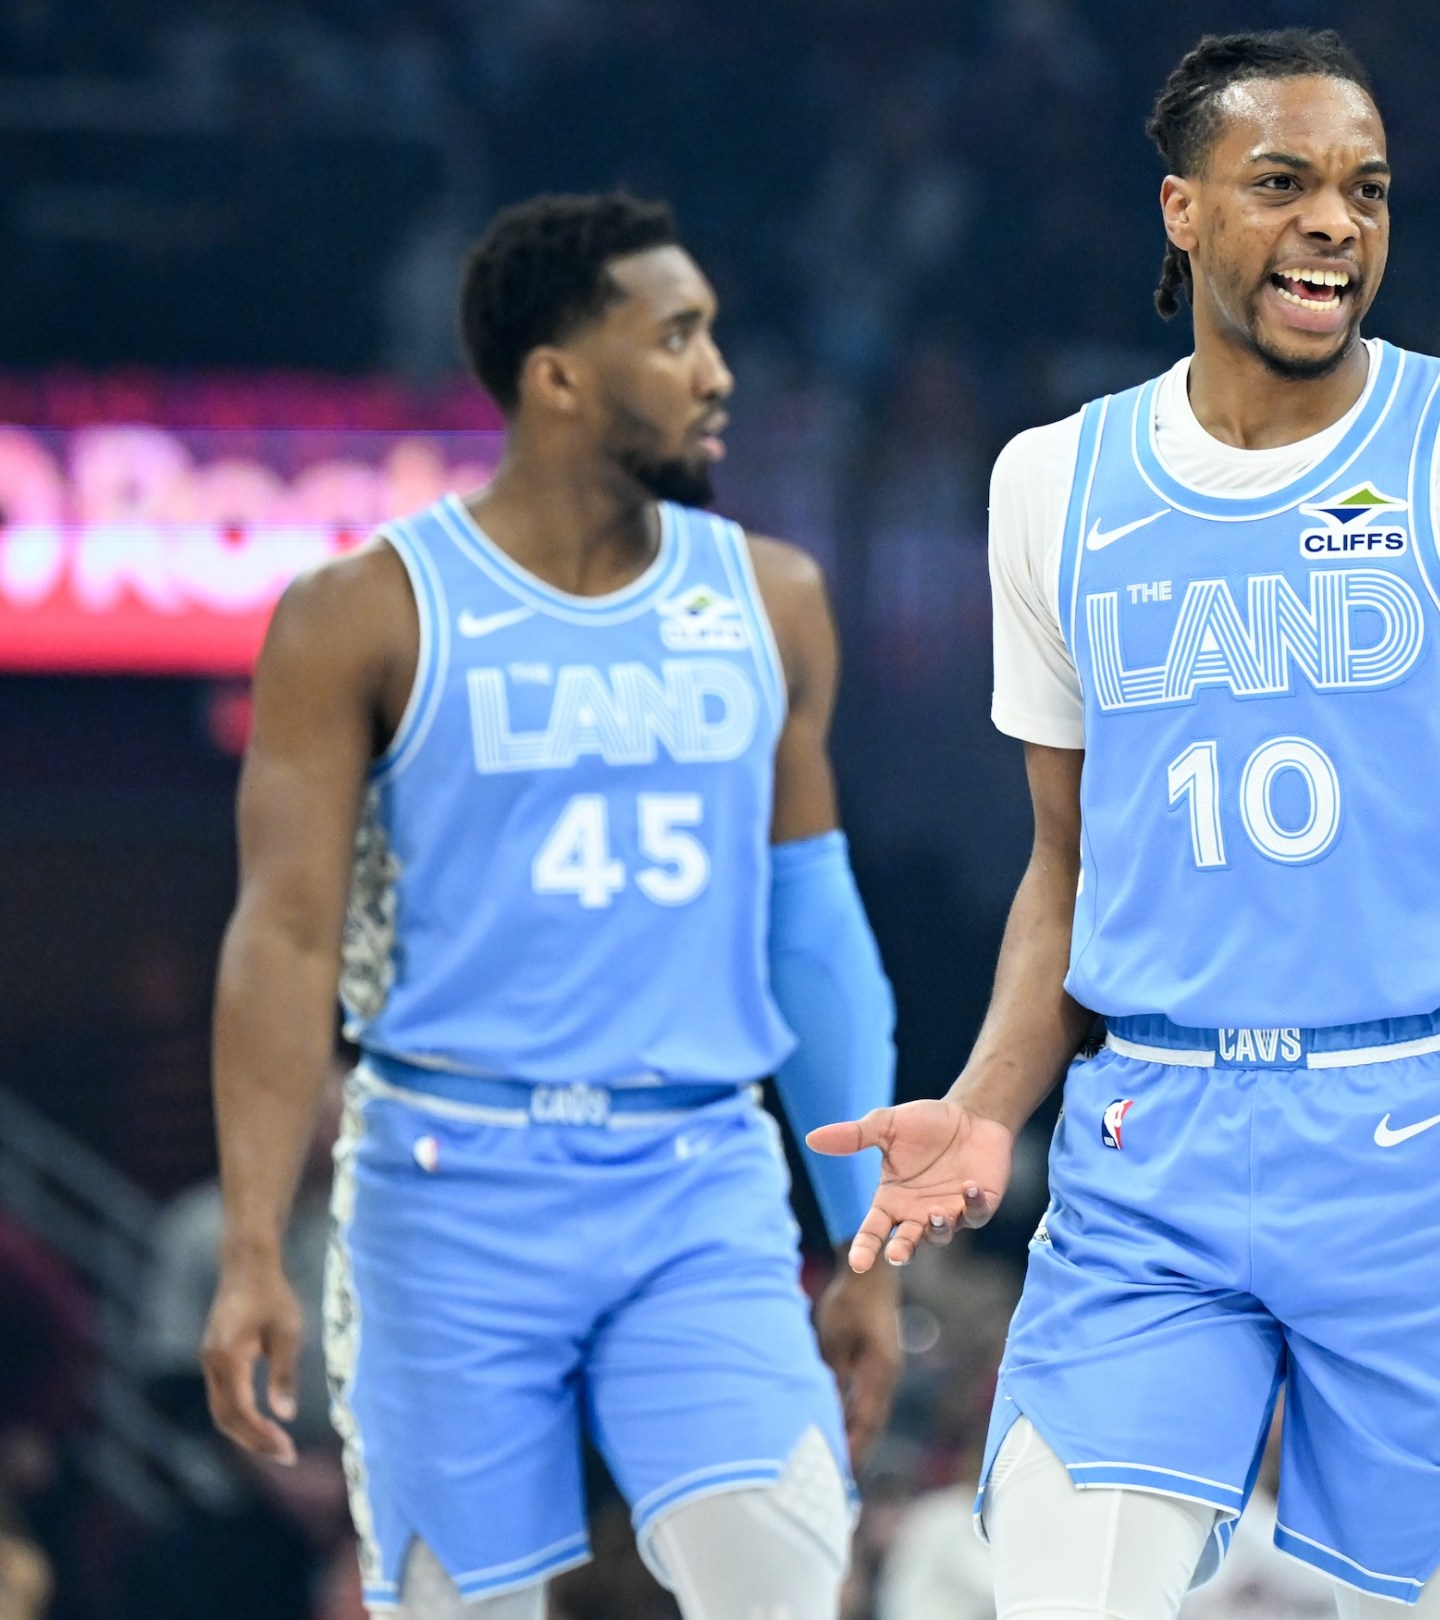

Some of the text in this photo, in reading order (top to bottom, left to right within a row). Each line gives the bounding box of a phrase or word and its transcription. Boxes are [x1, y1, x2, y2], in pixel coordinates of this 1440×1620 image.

[1126, 580, 1173, 604] THE
[1304, 532, 1404, 553] CLIFFS
[1085, 568, 1426, 712] LAND
[467, 658, 759, 774] LAND
[531, 792, 711, 909] 45
[1167, 735, 1341, 868] 10
[1218, 1027, 1302, 1062] CAVS
